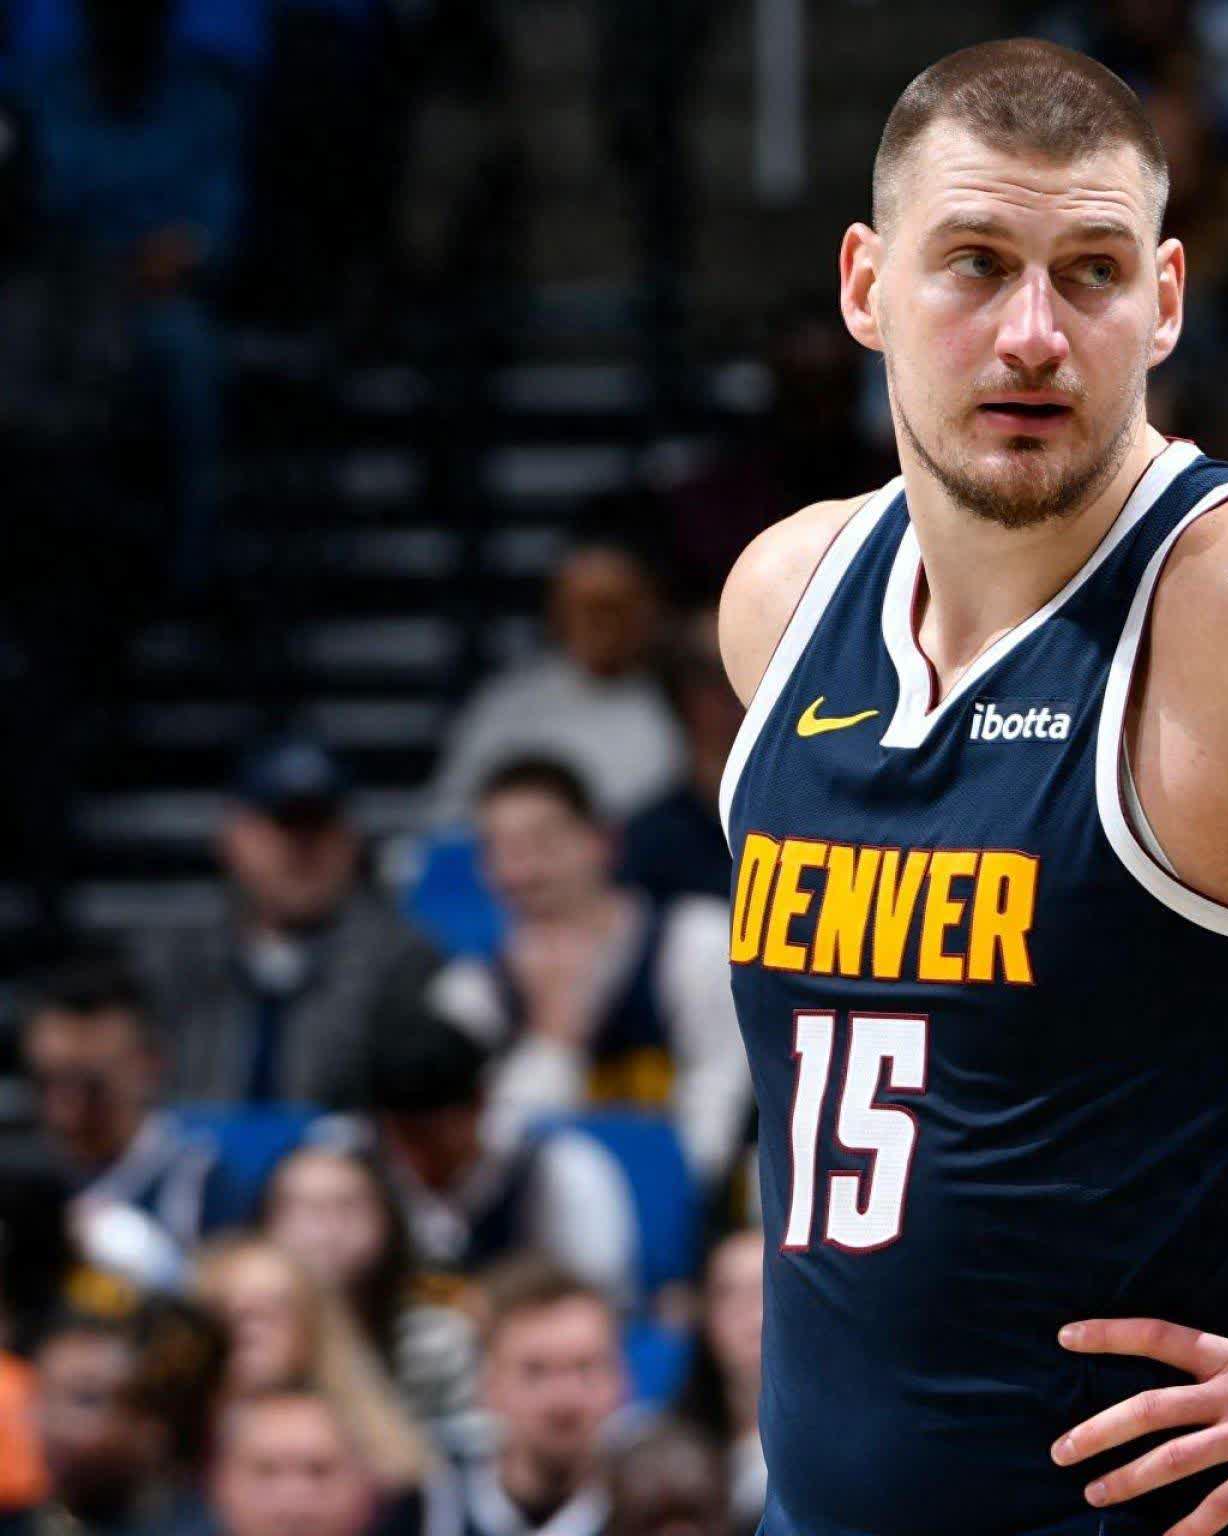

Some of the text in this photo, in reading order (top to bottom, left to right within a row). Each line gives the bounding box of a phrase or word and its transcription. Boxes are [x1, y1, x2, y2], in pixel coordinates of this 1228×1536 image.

[968, 702, 1072, 741] ibotta
[730, 831, 1039, 986] DENVER
[781, 1008, 929, 1254] 15
